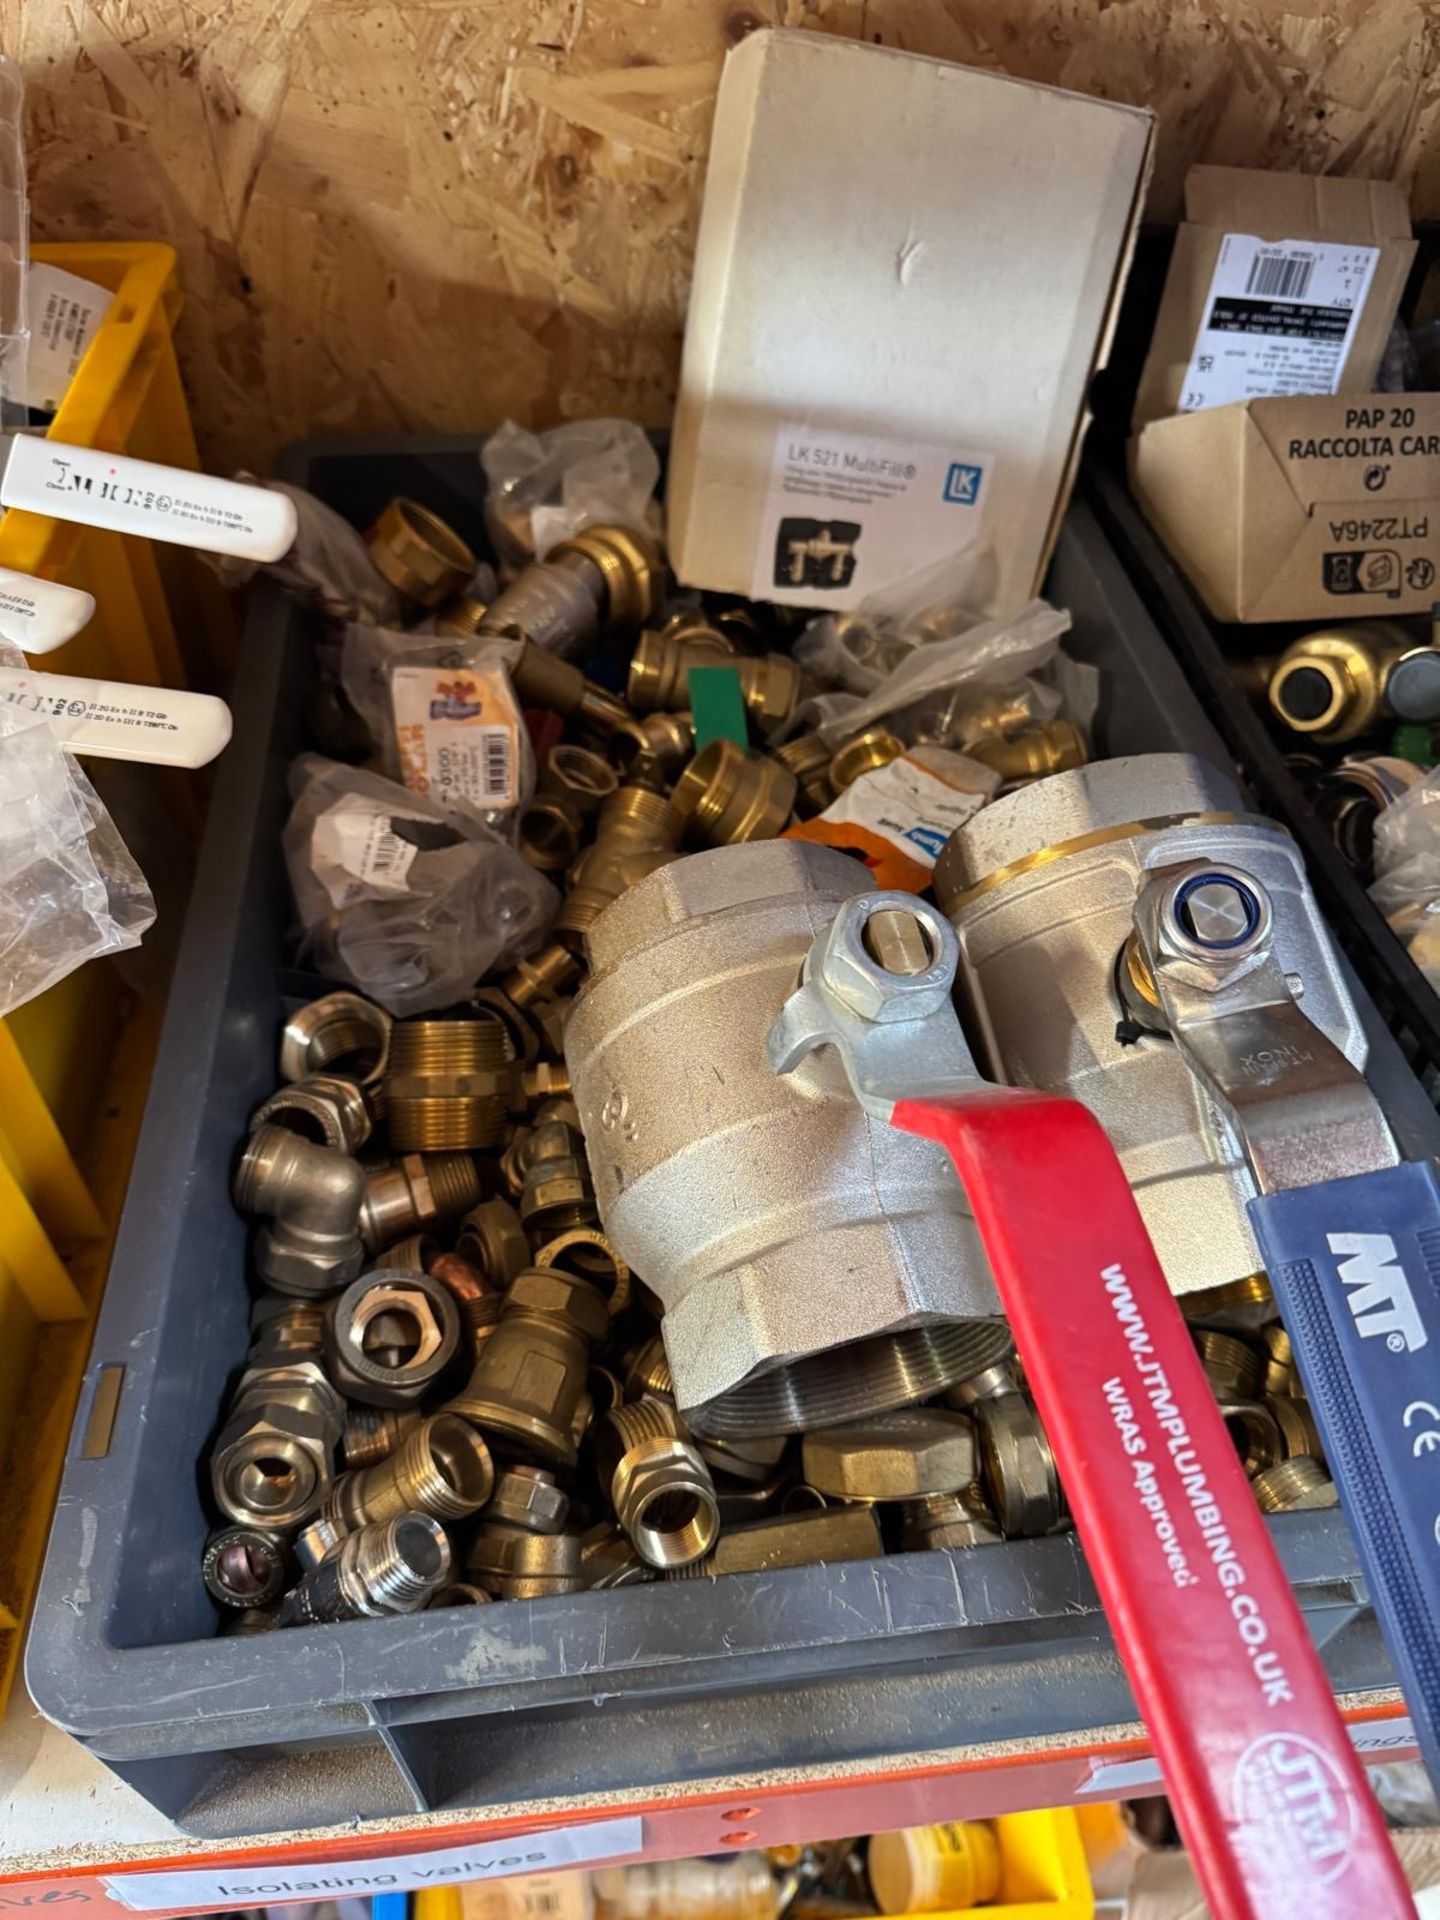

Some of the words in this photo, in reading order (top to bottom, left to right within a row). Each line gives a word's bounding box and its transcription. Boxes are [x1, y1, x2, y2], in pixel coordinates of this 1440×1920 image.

[1345, 408, 1385, 429] PAP
[1389, 407, 1416, 428] 20
[812, 447, 839, 466] 521
[1288, 436, 1394, 460] RACCOLTA
[1400, 435, 1440, 456] CAR
[1328, 516, 1429, 543] PT2246A
[1101, 1376, 1148, 1456] WRAS
[1100, 1262, 1295, 1706] WWW.JTMPLUMBING.CO.UK
[217, 1871, 398, 1897] Isolating
[411, 1849, 547, 1880] valves
